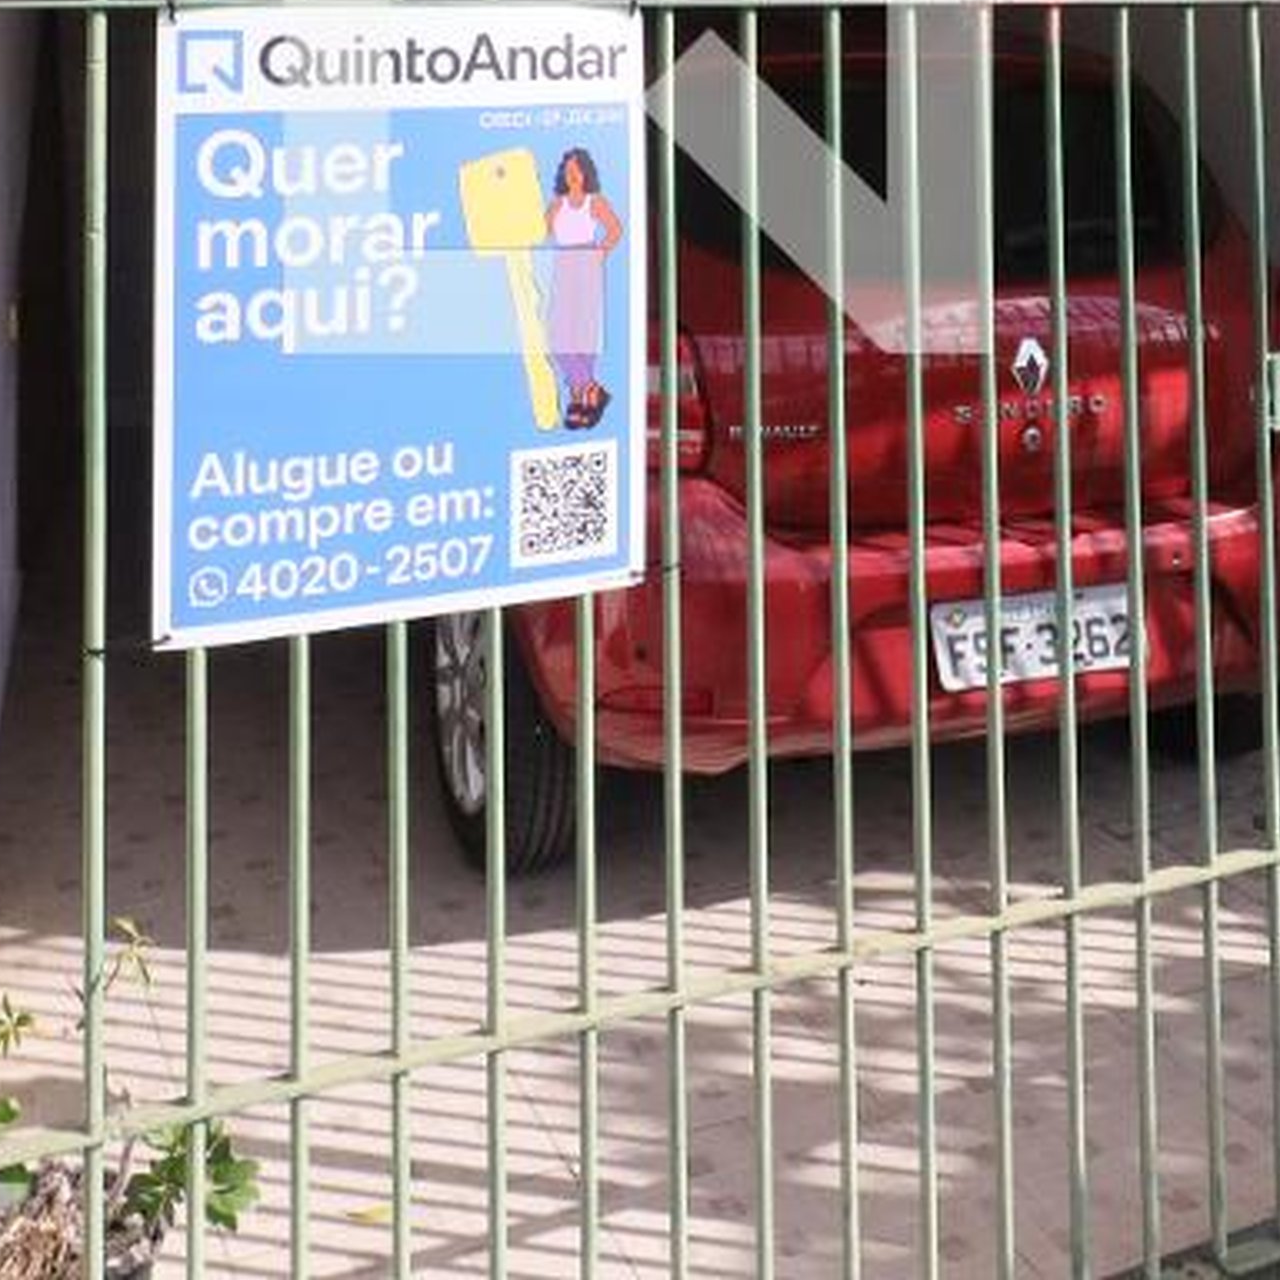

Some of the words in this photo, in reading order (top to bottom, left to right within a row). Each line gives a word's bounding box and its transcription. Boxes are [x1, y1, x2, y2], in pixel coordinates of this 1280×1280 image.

[258, 32, 628, 89] QuintoAndar
[196, 128, 404, 199] Quer
[196, 210, 440, 271] morar
[194, 264, 420, 354] aqui?
[190, 450, 382, 502] Alugue
[393, 441, 453, 480] ou
[188, 497, 395, 551] compre
[406, 485, 496, 528] em:
